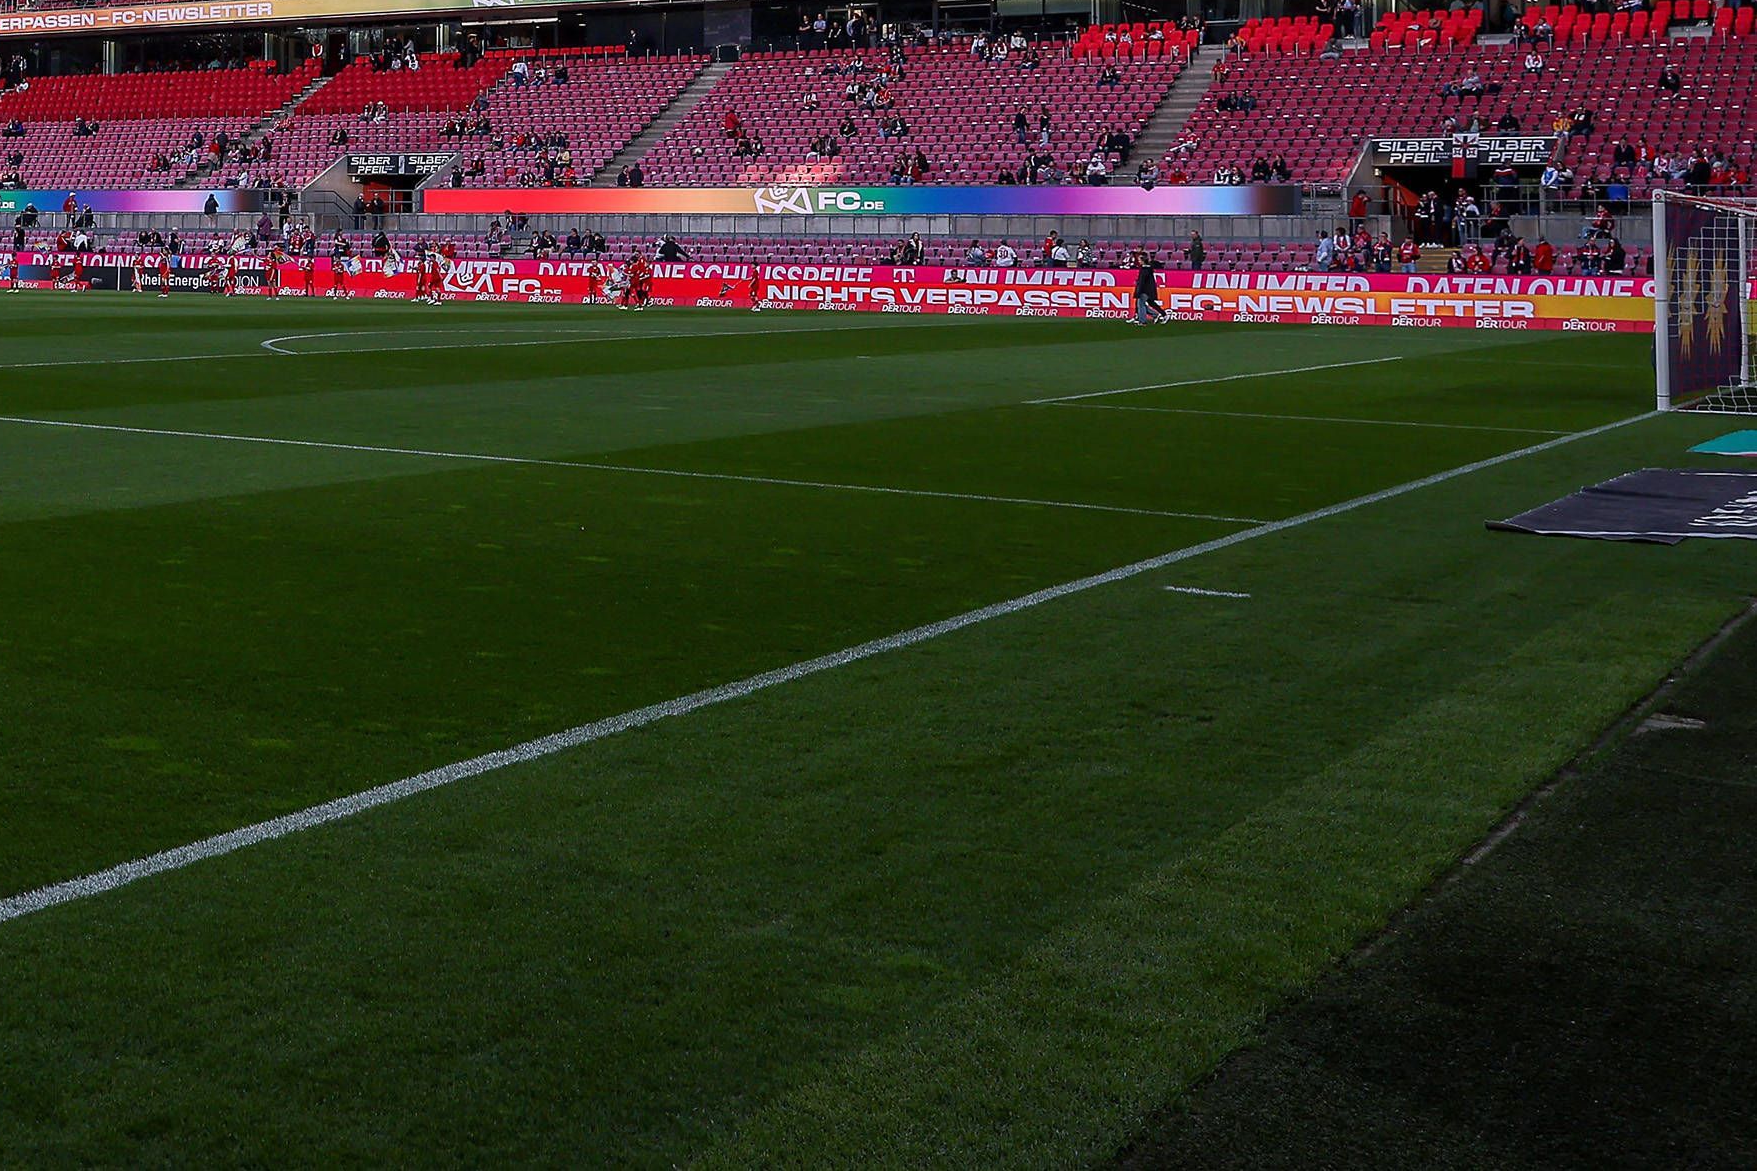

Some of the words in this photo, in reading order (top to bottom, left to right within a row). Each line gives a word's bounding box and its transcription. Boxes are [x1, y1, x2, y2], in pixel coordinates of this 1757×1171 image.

[111, 2, 274, 24] FC-NEWSLETTER
[1378, 141, 1445, 152] SILBER
[1477, 140, 1546, 151] SILBER
[350, 156, 391, 165] SILBER
[1389, 152, 1440, 163] PFEIL
[1487, 151, 1541, 162] PFEIL
[357, 165, 388, 174] PFEIL
[818, 191, 885, 210] FC.DE
[475, 291, 508, 301] DERTOUR
[528, 293, 562, 303] DERTOUR
[767, 285, 896, 303] NICHTS
[900, 287, 1129, 308] VERPASSEN
[1170, 292, 1534, 319] FC-NEWSLETTER
[696, 297, 733, 308] DERTOUR
[819, 300, 857, 311] DERTOUR
[881, 302, 922, 314] DERTOUR
[947, 303, 989, 315] DERTOUR
[1015, 304, 1058, 317] DERTOUR
[1085, 306, 1129, 319] DERTOUR
[1233, 311, 1280, 323] DERTOUR
[1311, 313, 1360, 325] DERTOUR
[1391, 315, 1442, 328] DERTOUR
[1475, 317, 1527, 330] DERTOUR
[1562, 318, 1616, 331] DERTOUR
